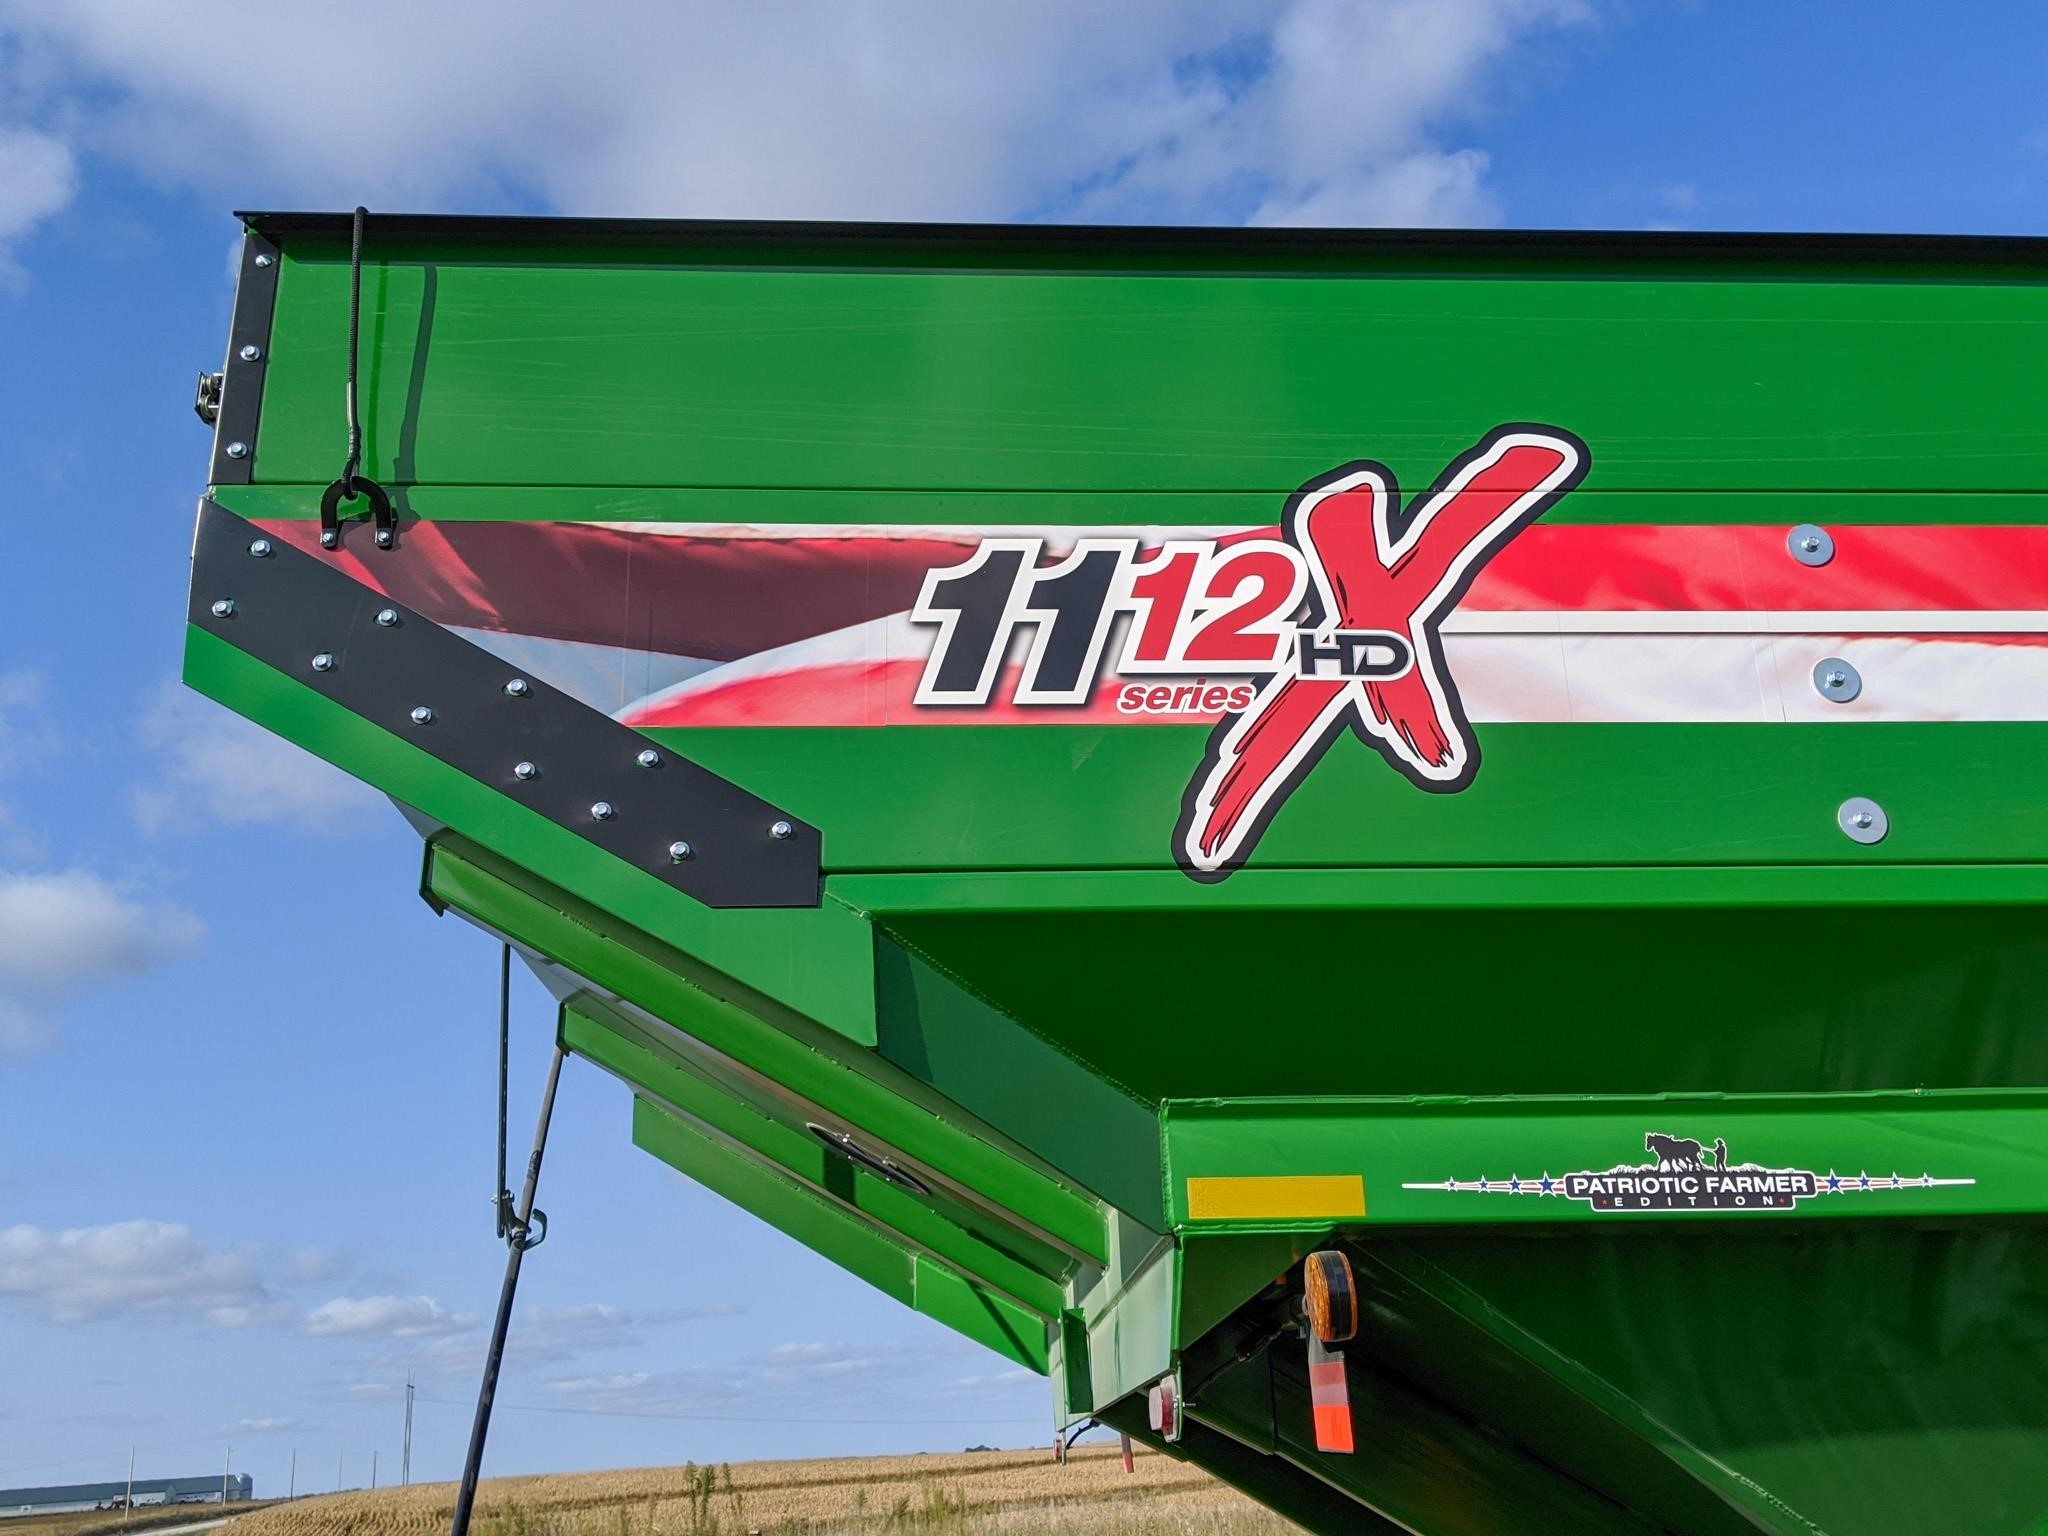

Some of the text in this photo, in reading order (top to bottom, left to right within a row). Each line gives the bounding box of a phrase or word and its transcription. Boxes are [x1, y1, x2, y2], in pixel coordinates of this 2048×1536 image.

[1300, 633, 1409, 677] HD
[1120, 681, 1253, 712] series
[1573, 1175, 1808, 1195] PATRIOTIC FARMER
[1614, 1196, 1773, 1207] EDITION
